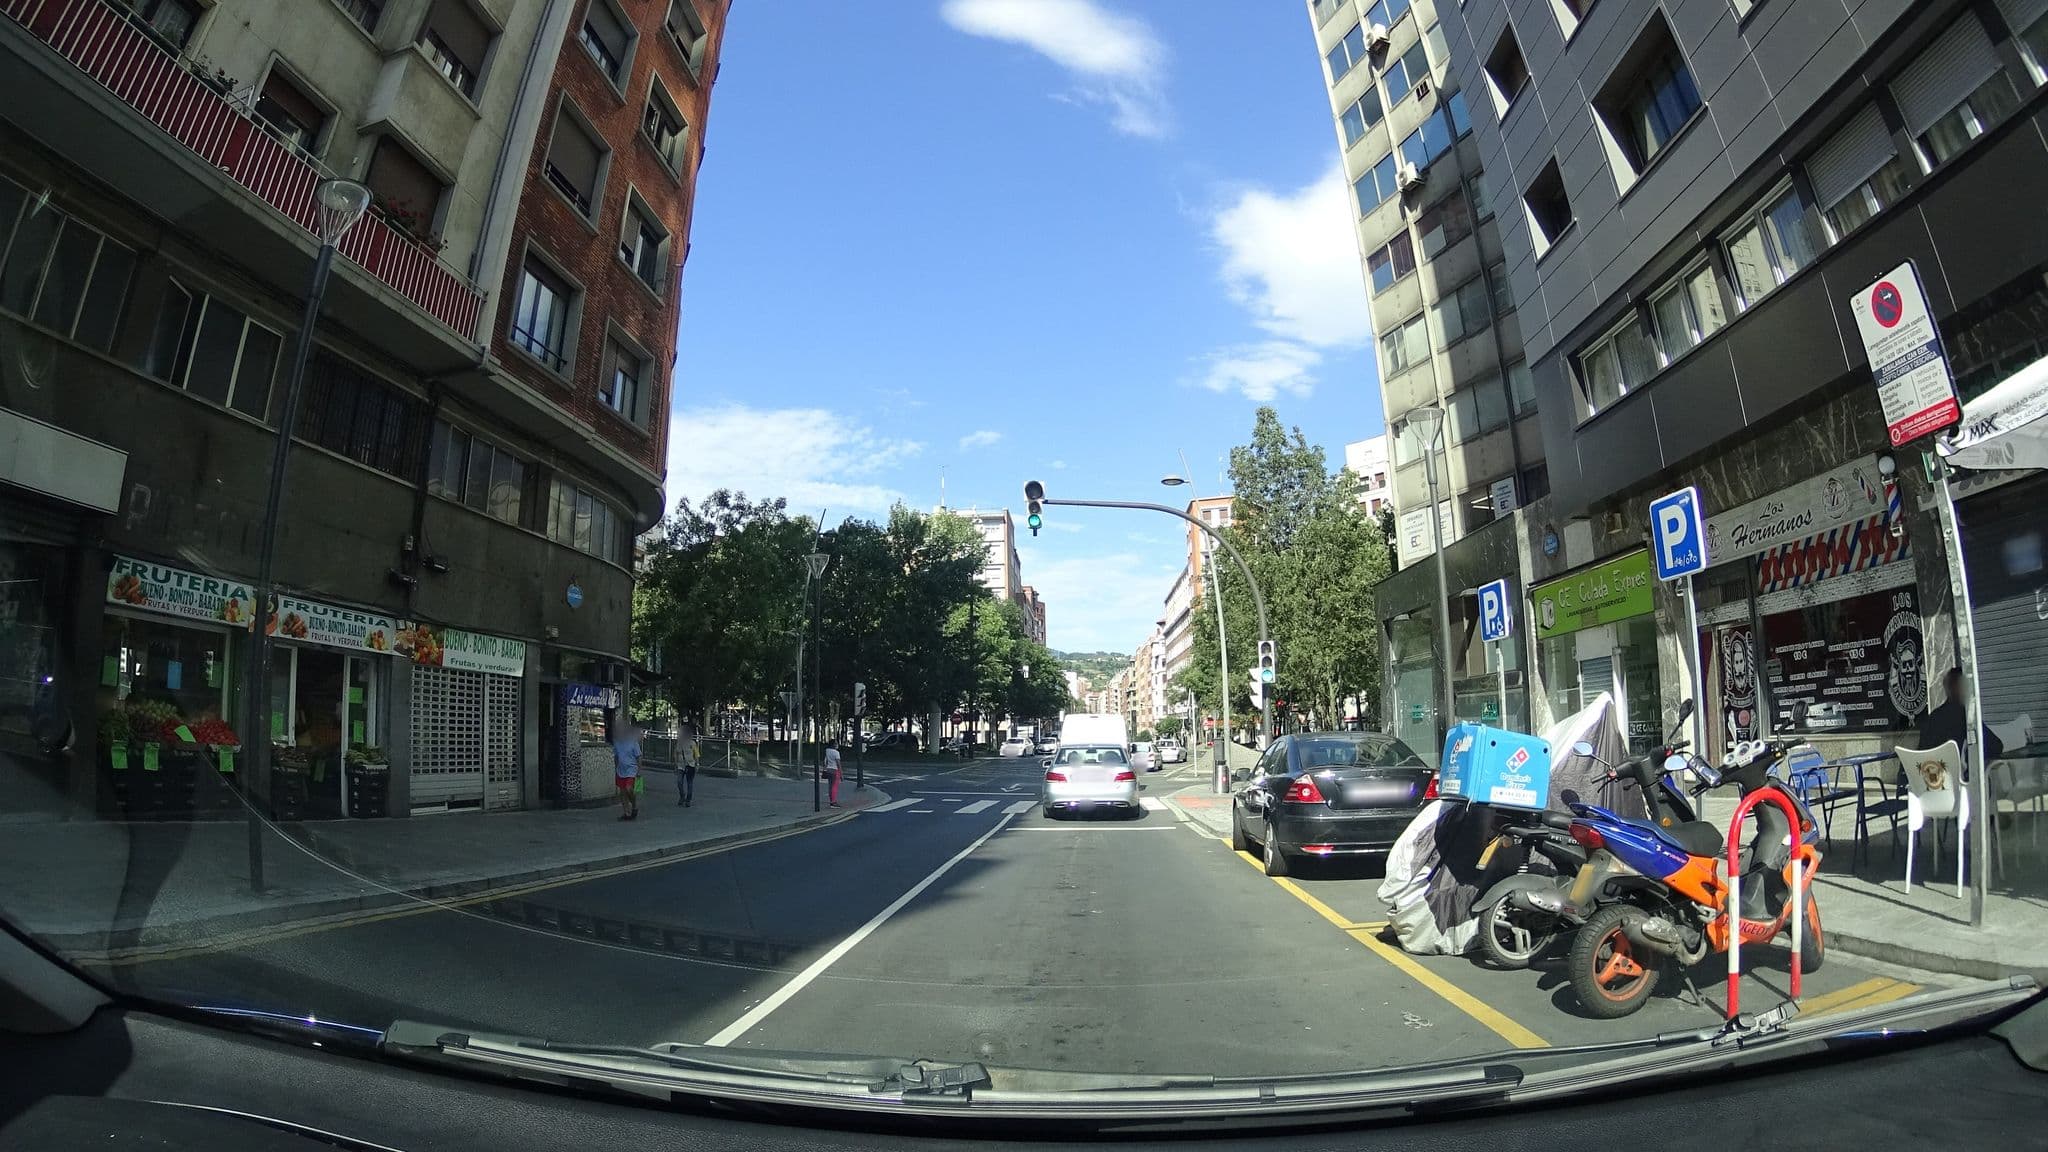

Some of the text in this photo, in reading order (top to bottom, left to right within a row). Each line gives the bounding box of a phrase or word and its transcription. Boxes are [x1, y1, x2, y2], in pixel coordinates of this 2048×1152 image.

[1969, 412, 1998, 440] MAX
[1760, 501, 1784, 520] Los
[1659, 504, 1688, 570] P
[1731, 509, 1813, 550] Hermanos
[116, 560, 248, 601] FRUTERIA
[169, 586, 194, 607] BONITO
[1892, 592, 1912, 611] LOS
[180, 606, 213, 618] VERDURAS
[282, 600, 390, 628] FRUTERIA
[1483, 590, 1498, 635] P
[309, 616, 367, 638] BUENO BONITO BARATO
[311, 632, 332, 643] FRUTAS
[338, 637, 362, 648] VERDURAS
[445, 630, 524, 661] BUENO BONITO BARATO
[450, 658, 476, 668] Frutas
[485, 662, 516, 672] verduras
